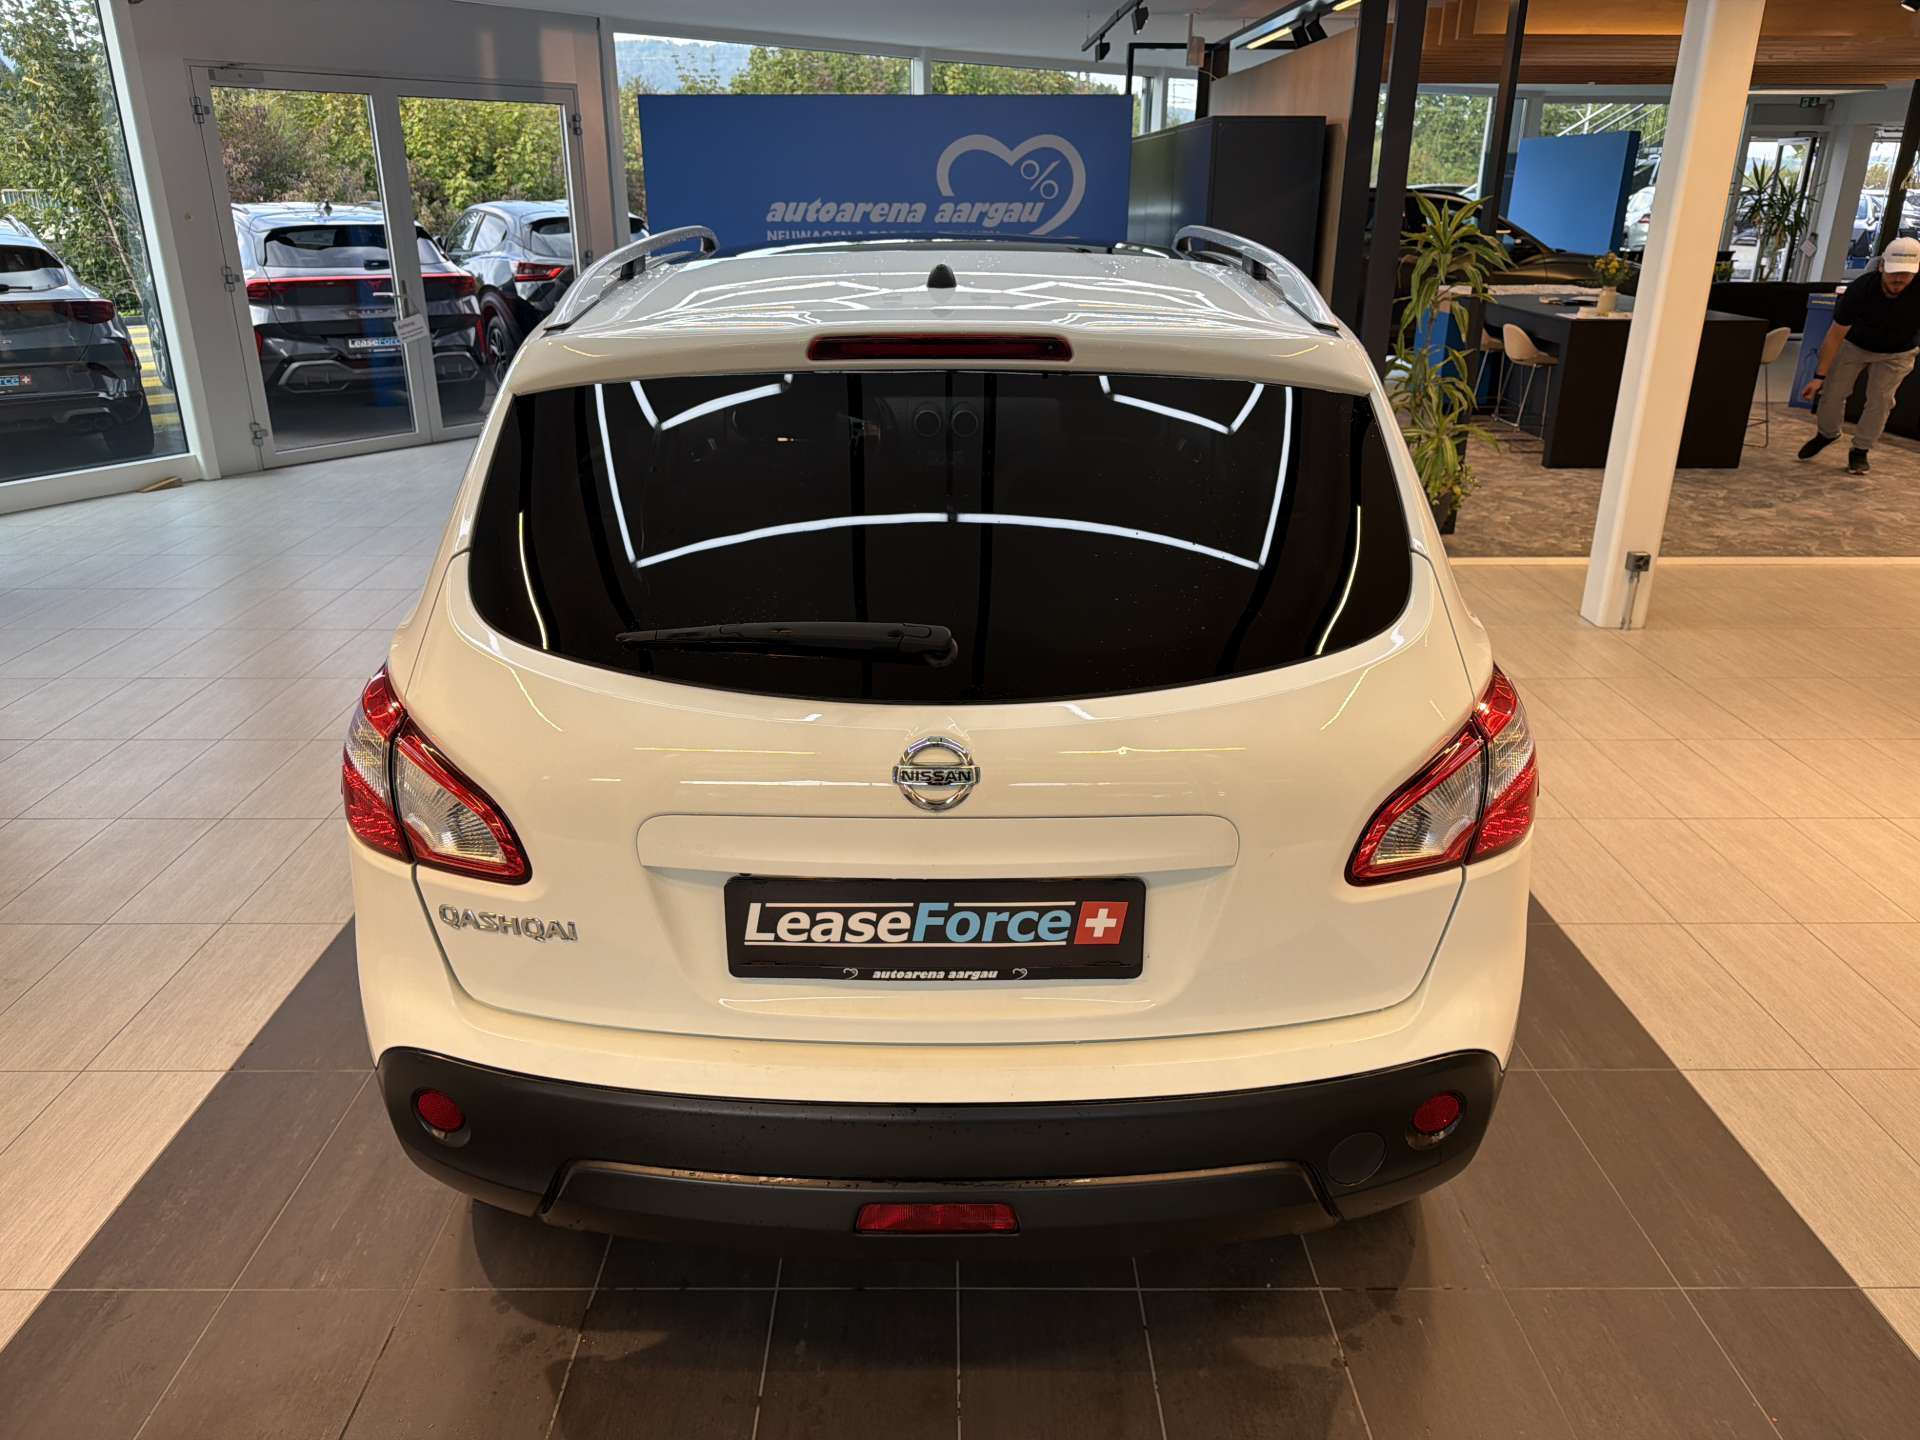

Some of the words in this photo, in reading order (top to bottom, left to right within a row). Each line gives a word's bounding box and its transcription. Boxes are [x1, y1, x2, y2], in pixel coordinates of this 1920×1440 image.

[766, 198, 927, 223] autoarena
[934, 201, 1045, 227] aargau
[348, 338, 401, 349] LeaseForc
[901, 770, 971, 782] NISSAN
[439, 904, 578, 942] QASHQAI
[744, 902, 1072, 943] LeaseForce
[872, 970, 945, 979] autoarena
[947, 970, 998, 980] aargau
